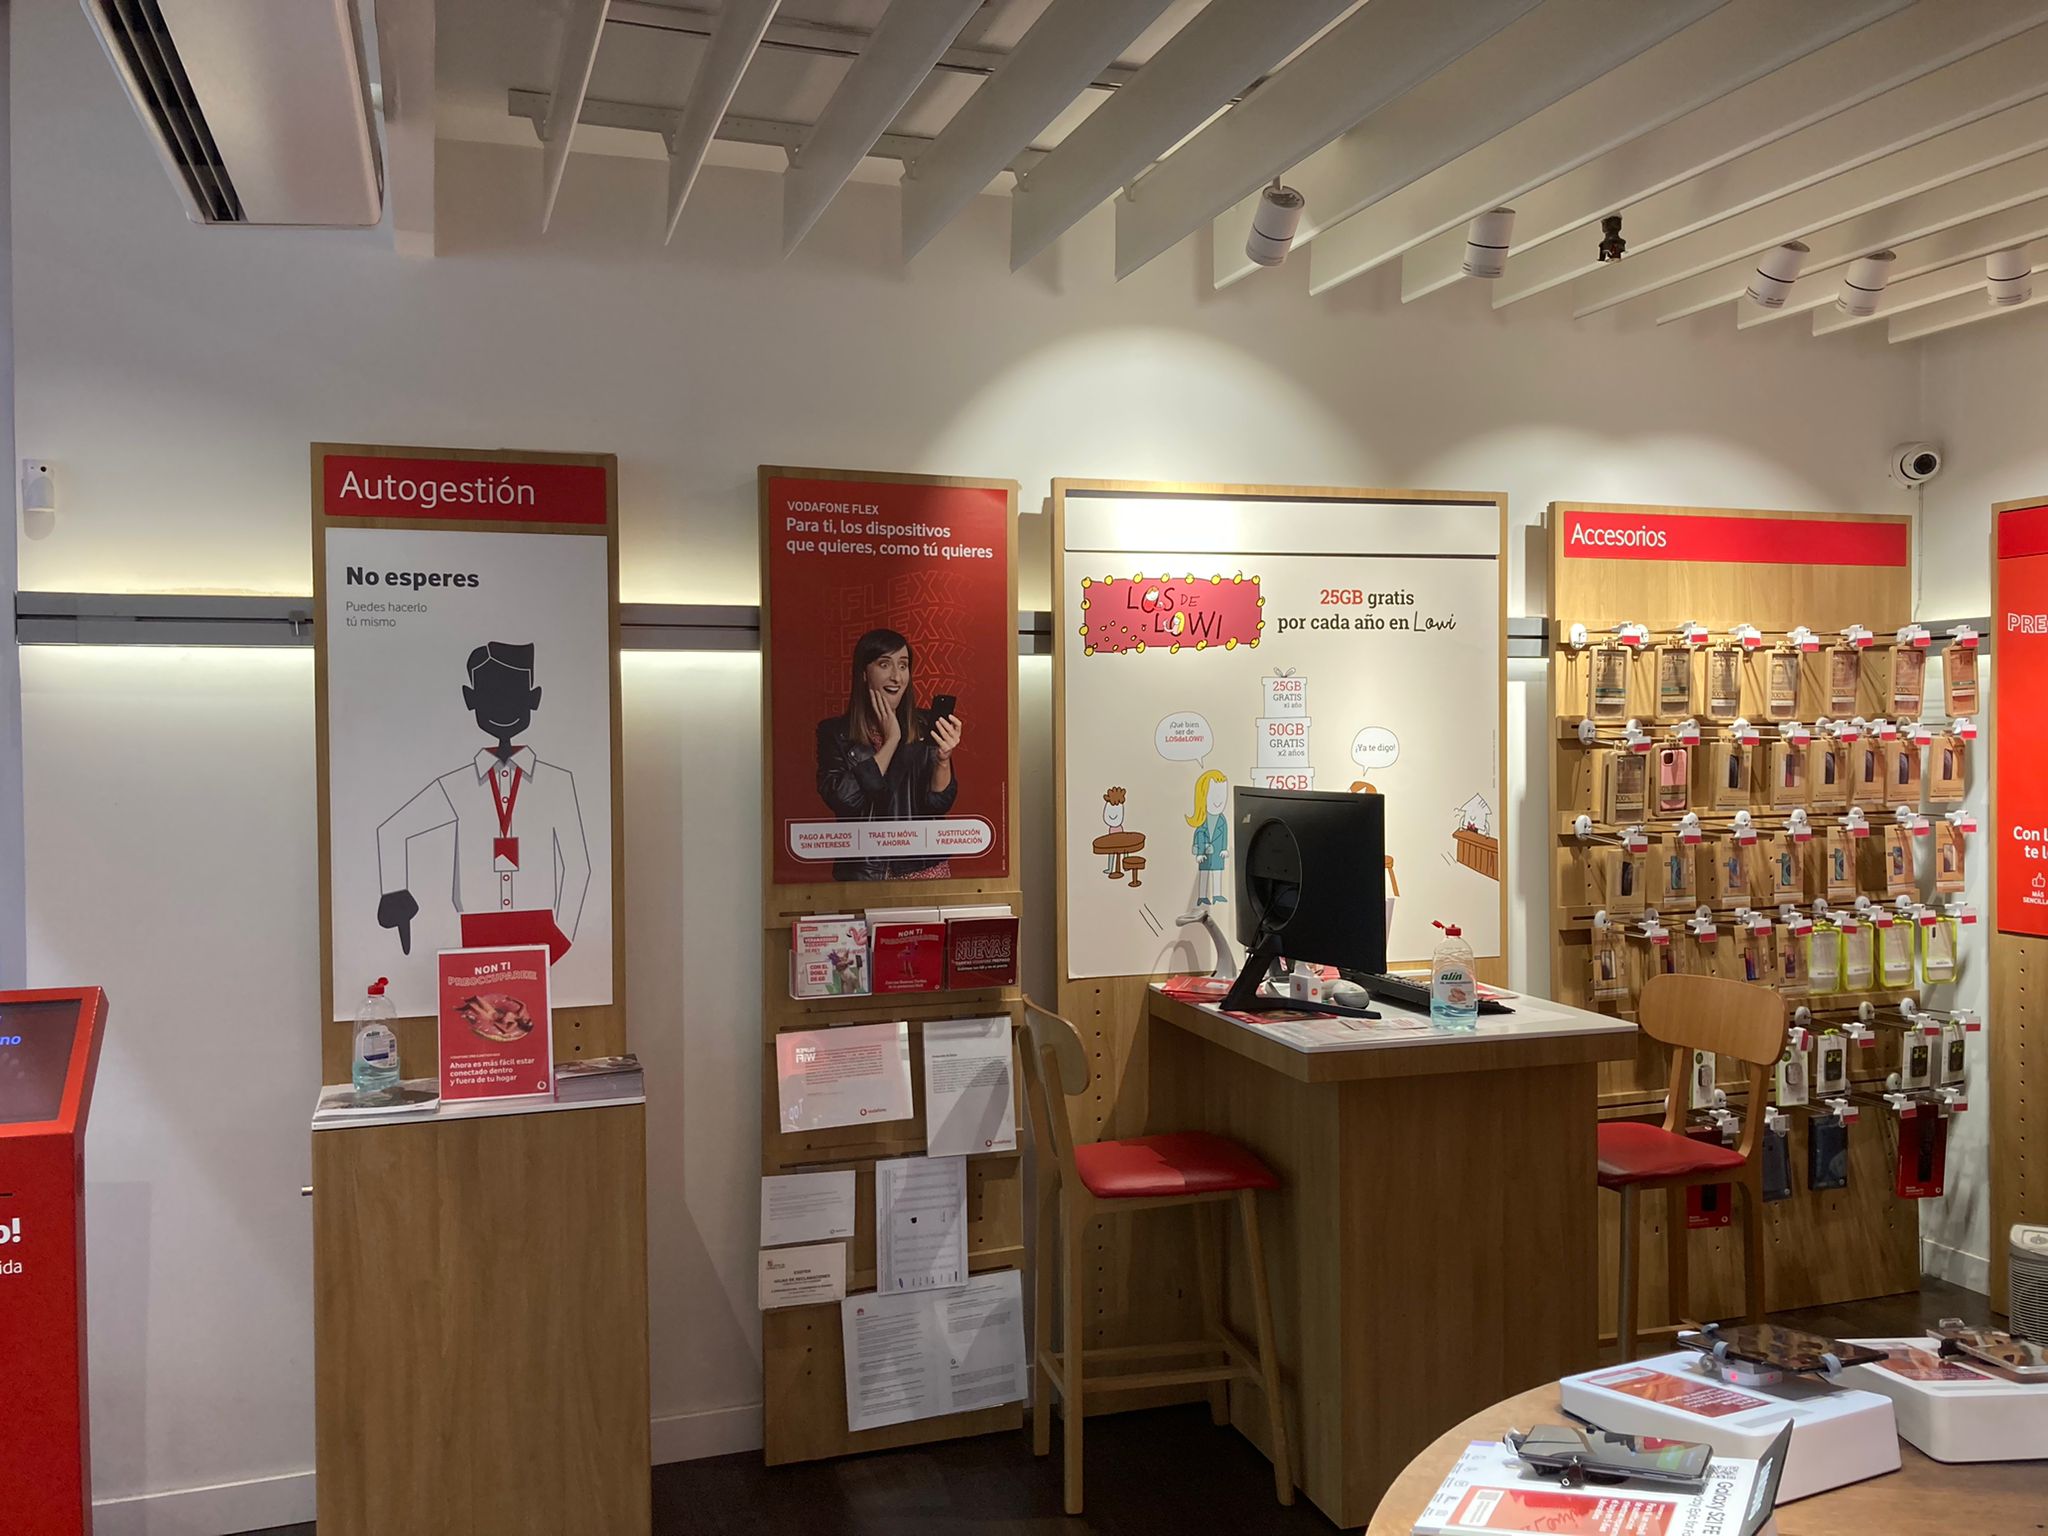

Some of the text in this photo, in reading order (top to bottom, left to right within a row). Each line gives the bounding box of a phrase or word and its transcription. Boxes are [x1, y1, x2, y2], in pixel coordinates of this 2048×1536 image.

[339, 470, 535, 508] Autogestión
[787, 501, 879, 515] VODAFONE FLEX
[786, 518, 951, 538] Para ti, los dispositivos
[1571, 523, 1667, 548] Accesorios
[786, 540, 994, 560] que quieres, como tú quieres
[346, 566, 480, 590] No esperes
[1127, 585, 1200, 613] LOS DE
[1320, 588, 1414, 608] 25GB gratis
[346, 601, 428, 613] Puedes hacerlo
[346, 616, 396, 628] tú mismo
[1153, 612, 1222, 639] LOWI
[1277, 610, 1457, 634] por cada año en Lowi
[2008, 612, 2048, 634] PRE
[1272, 680, 1302, 692] 25GB
[1268, 723, 1305, 736] 50GB
[1270, 738, 1305, 748] GRATIS
[1266, 774, 1308, 790] 75GB
[897, 830, 918, 838] MÓVIL
[938, 828, 981, 837] SUSTITUCIÓN
[2013, 826, 2040, 841] Con
[942, 836, 983, 845] REPARACIÓN
[2024, 845, 2039, 859] te
[474, 962, 511, 976] NON TI
[1441, 972, 1463, 981] alin
[450, 1069, 488, 1077] conectado
[450, 1079, 456, 1087] y
[496, 1075, 517, 1083] hogar
[1706, 1481, 1734, 1512] Galaxy
[1702, 1524, 1722, 1536] FE
